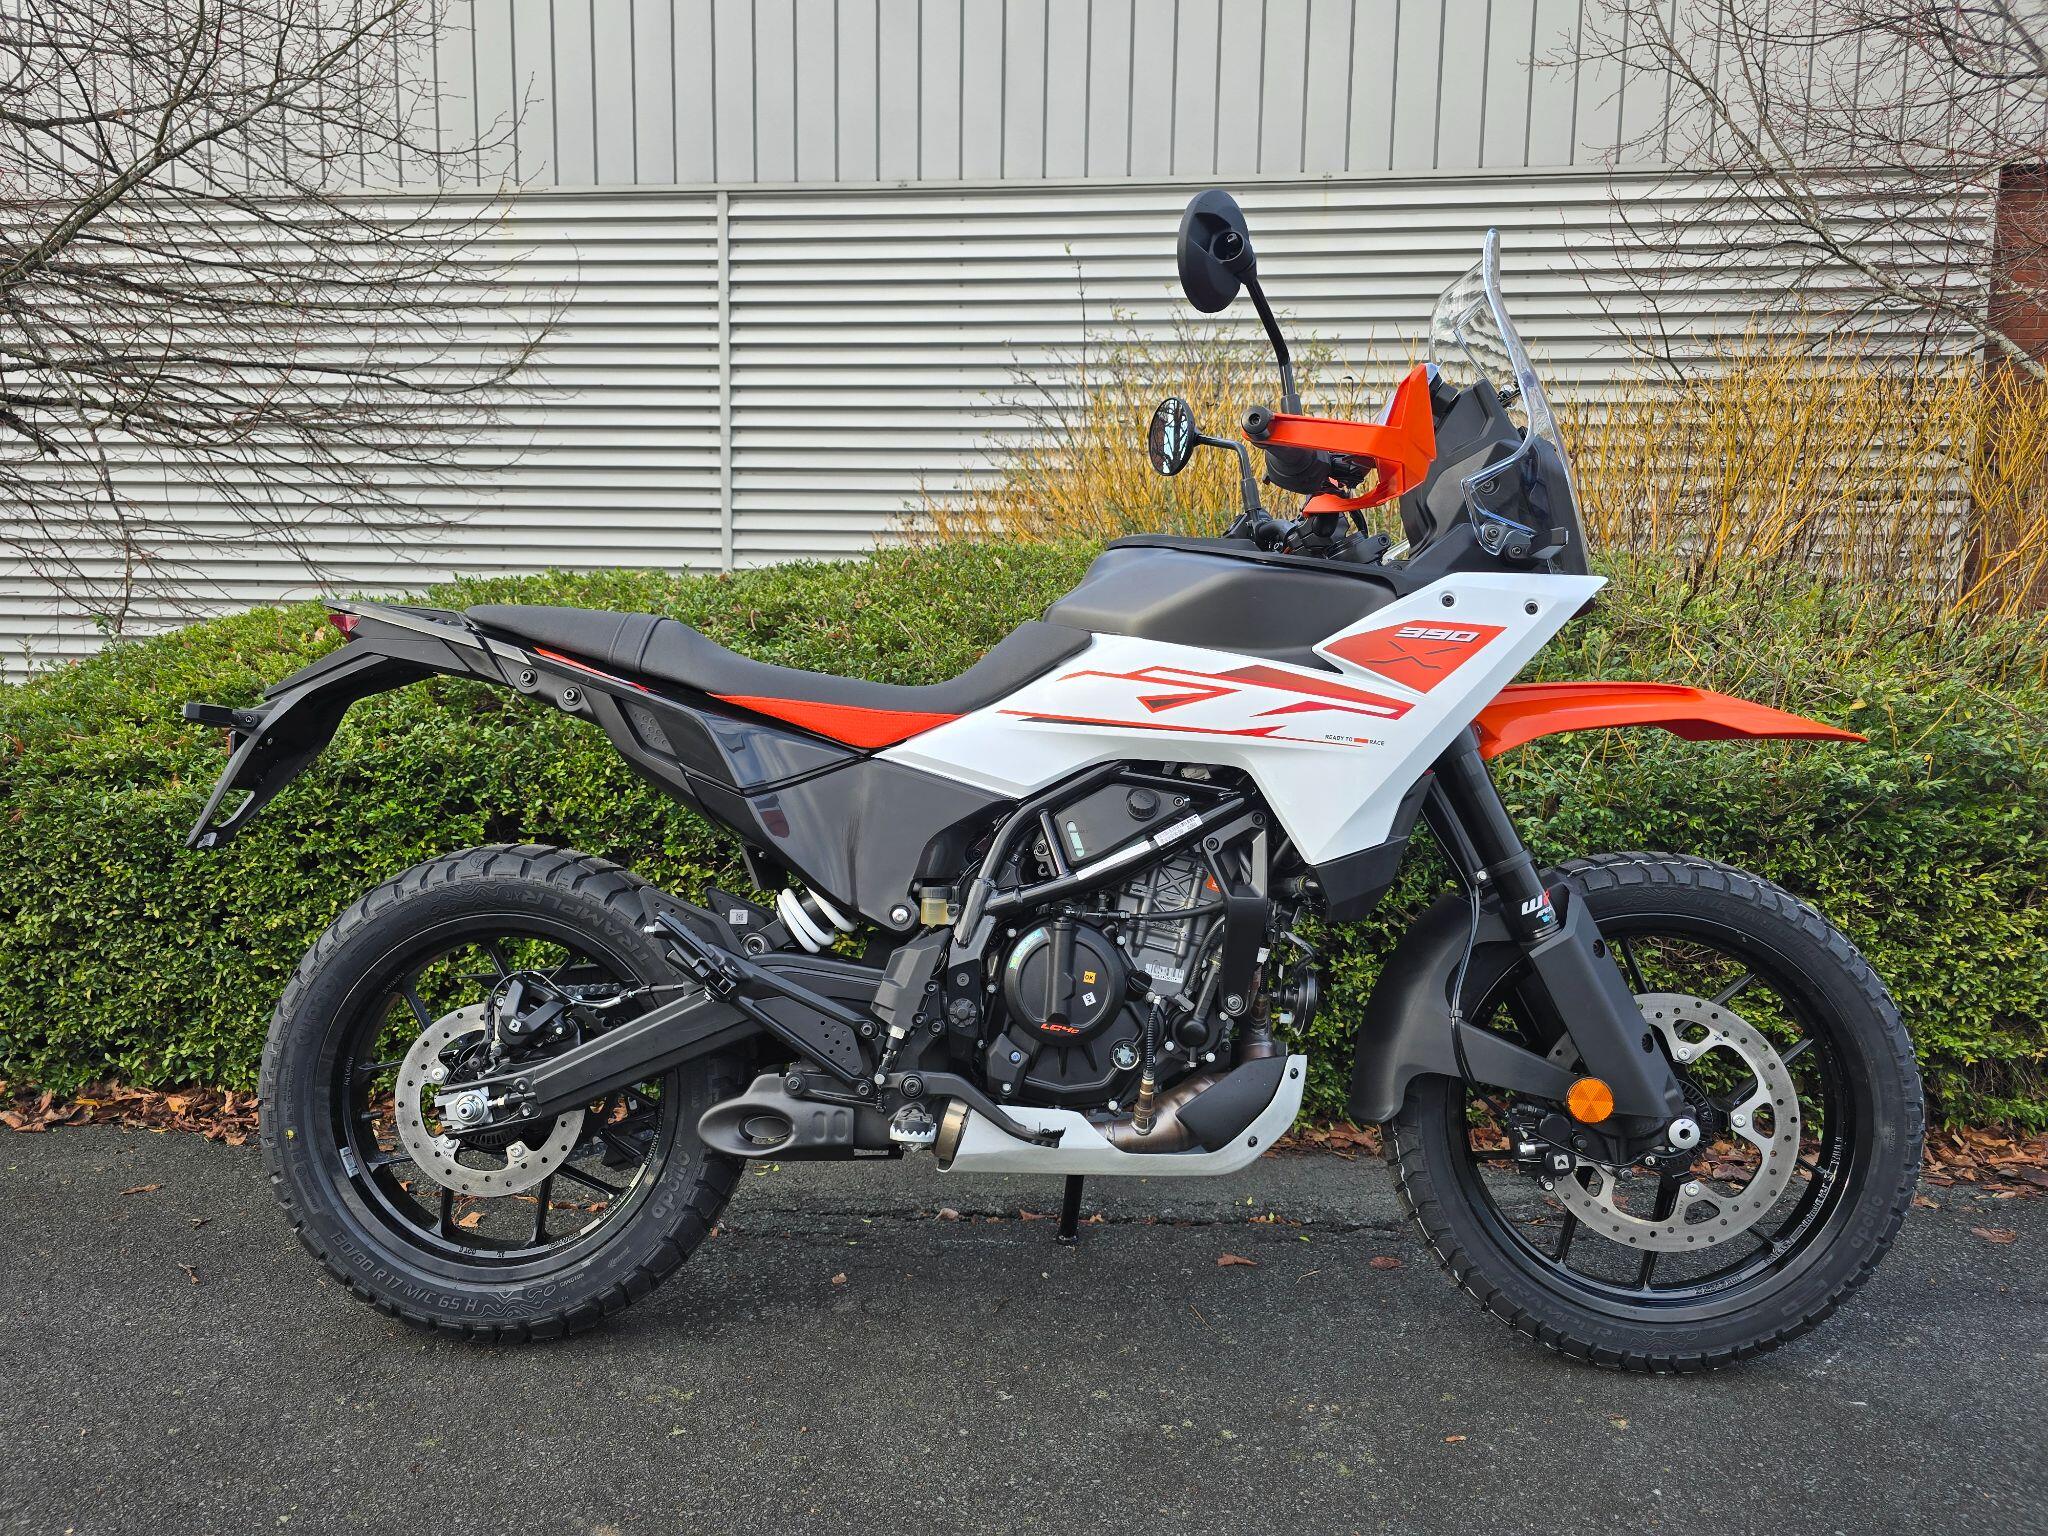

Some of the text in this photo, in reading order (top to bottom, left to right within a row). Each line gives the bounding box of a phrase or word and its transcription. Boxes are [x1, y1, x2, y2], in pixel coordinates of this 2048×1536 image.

[1394, 626, 1480, 643] 390
[651, 1150, 691, 1219] apollo
[1851, 1195, 1884, 1249] apollo
[330, 1230, 375, 1272] 130/80
[402, 1282, 437, 1304] M/C
[438, 1295, 461, 1311] 65
[464, 1298, 479, 1312] H
